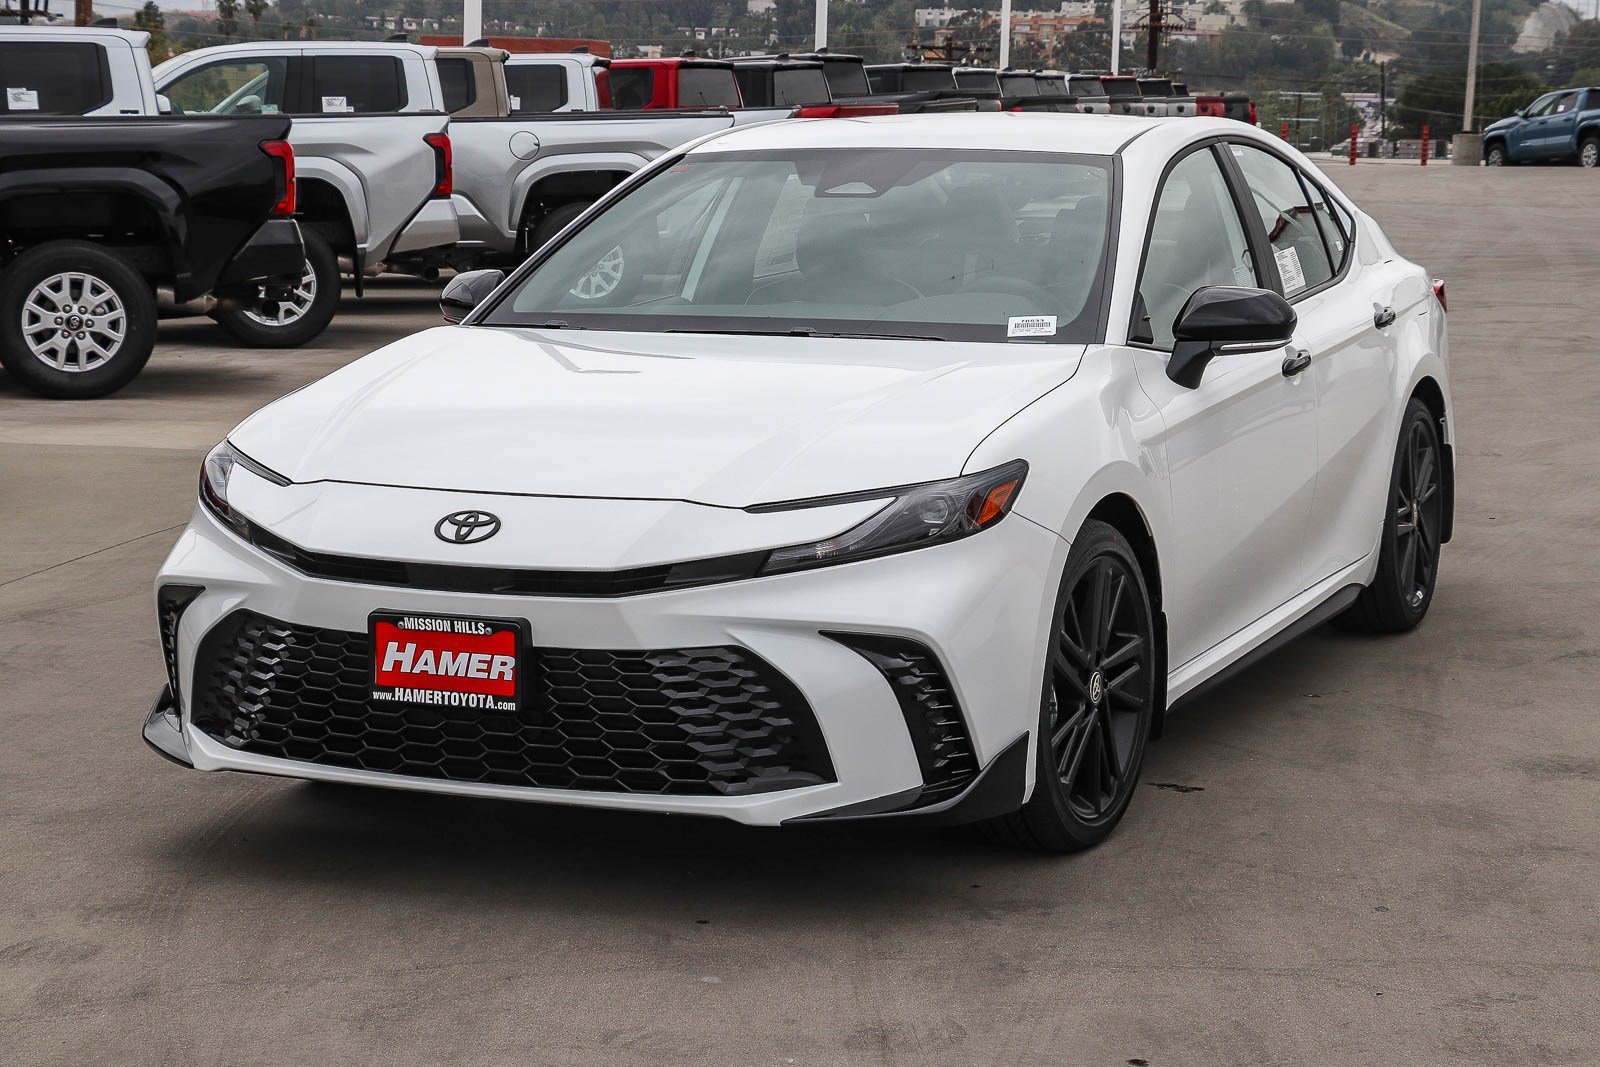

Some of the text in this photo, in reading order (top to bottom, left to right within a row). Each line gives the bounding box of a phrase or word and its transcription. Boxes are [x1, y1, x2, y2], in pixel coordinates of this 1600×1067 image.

[404, 617, 485, 635] MISSION HILLS
[382, 641, 516, 681] HAMER
[372, 687, 516, 711] www.HAMERTOYOTA.com
